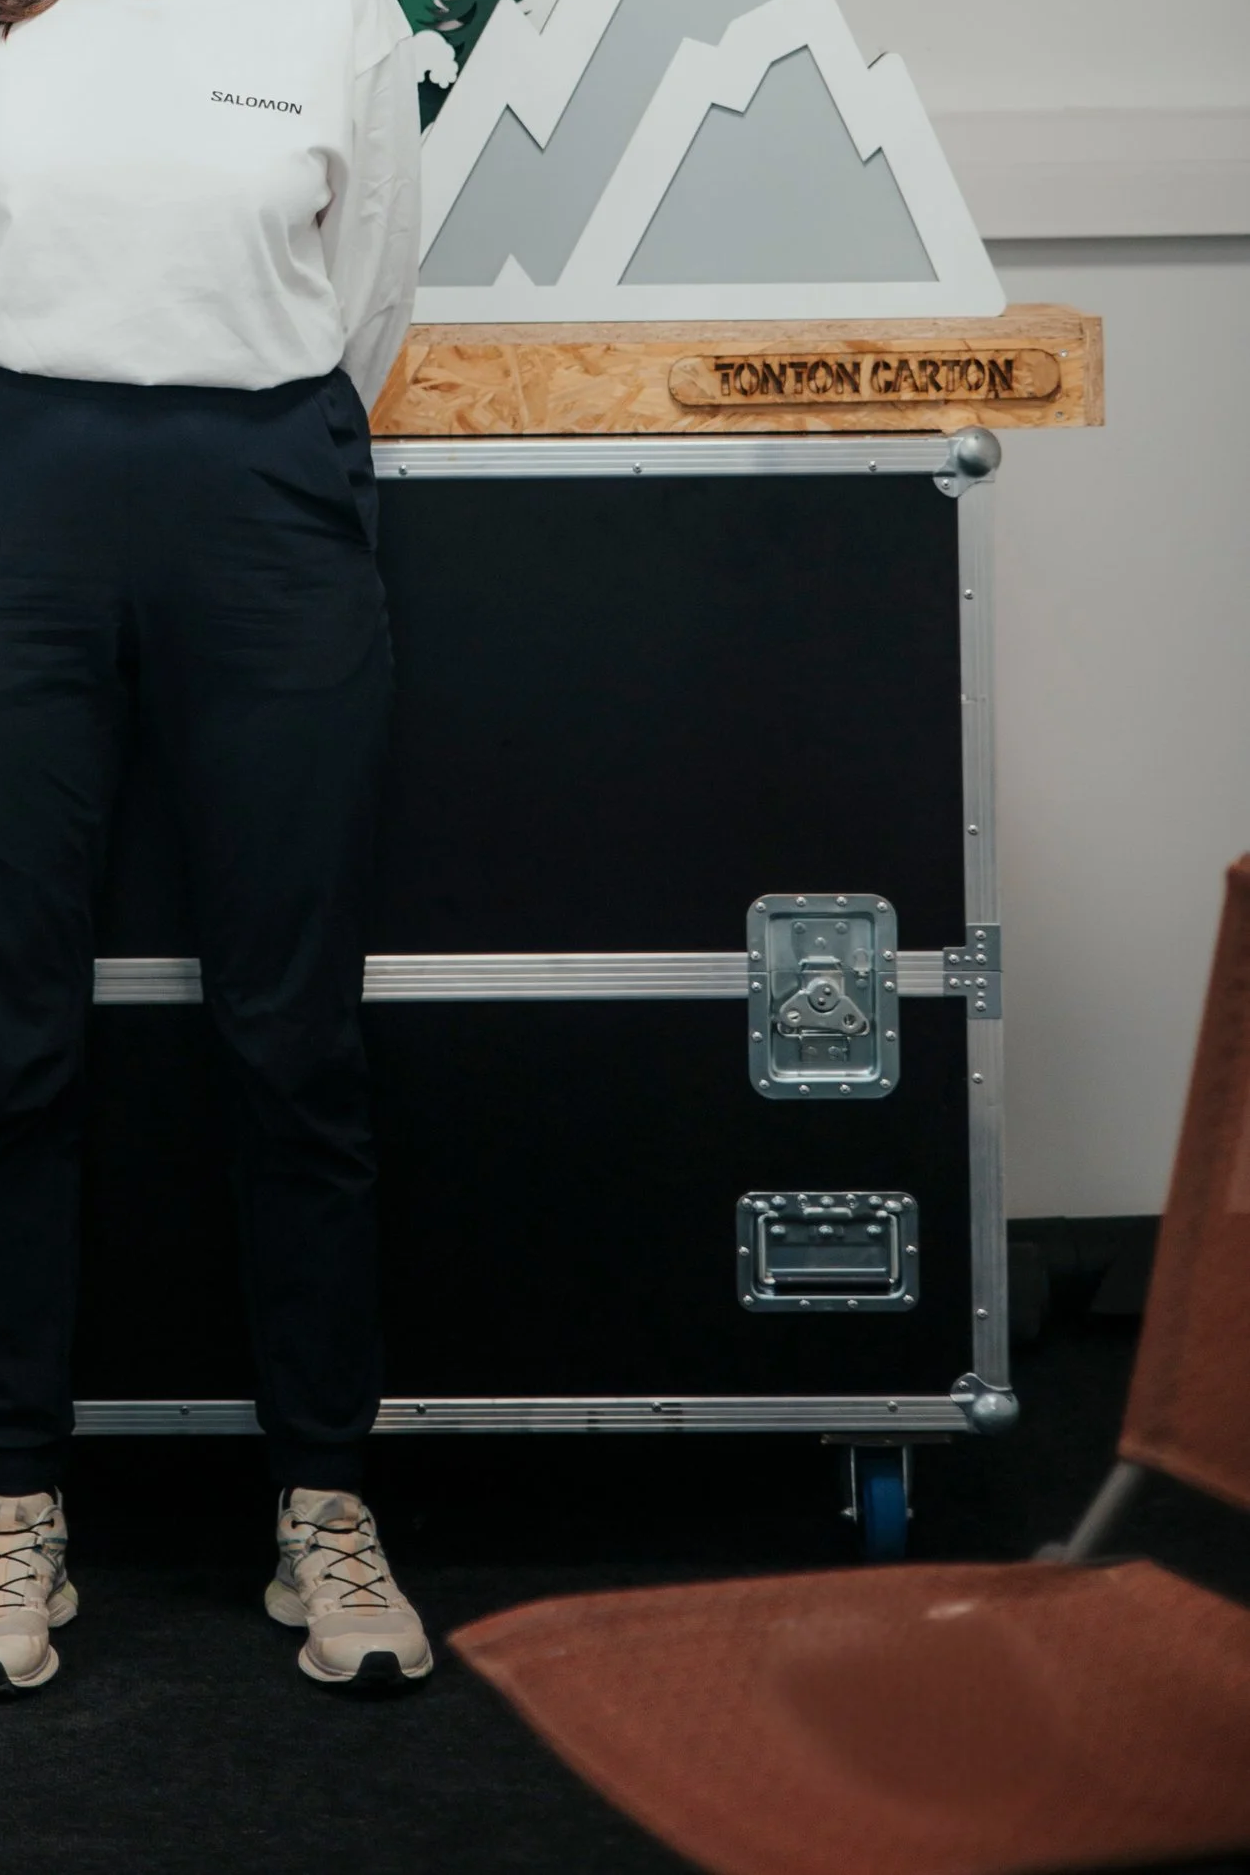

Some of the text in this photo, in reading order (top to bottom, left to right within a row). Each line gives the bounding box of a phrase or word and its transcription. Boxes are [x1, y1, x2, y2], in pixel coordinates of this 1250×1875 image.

[210, 90, 303, 116] SALOMON
[714, 358, 1014, 396] TONTON CARTON
